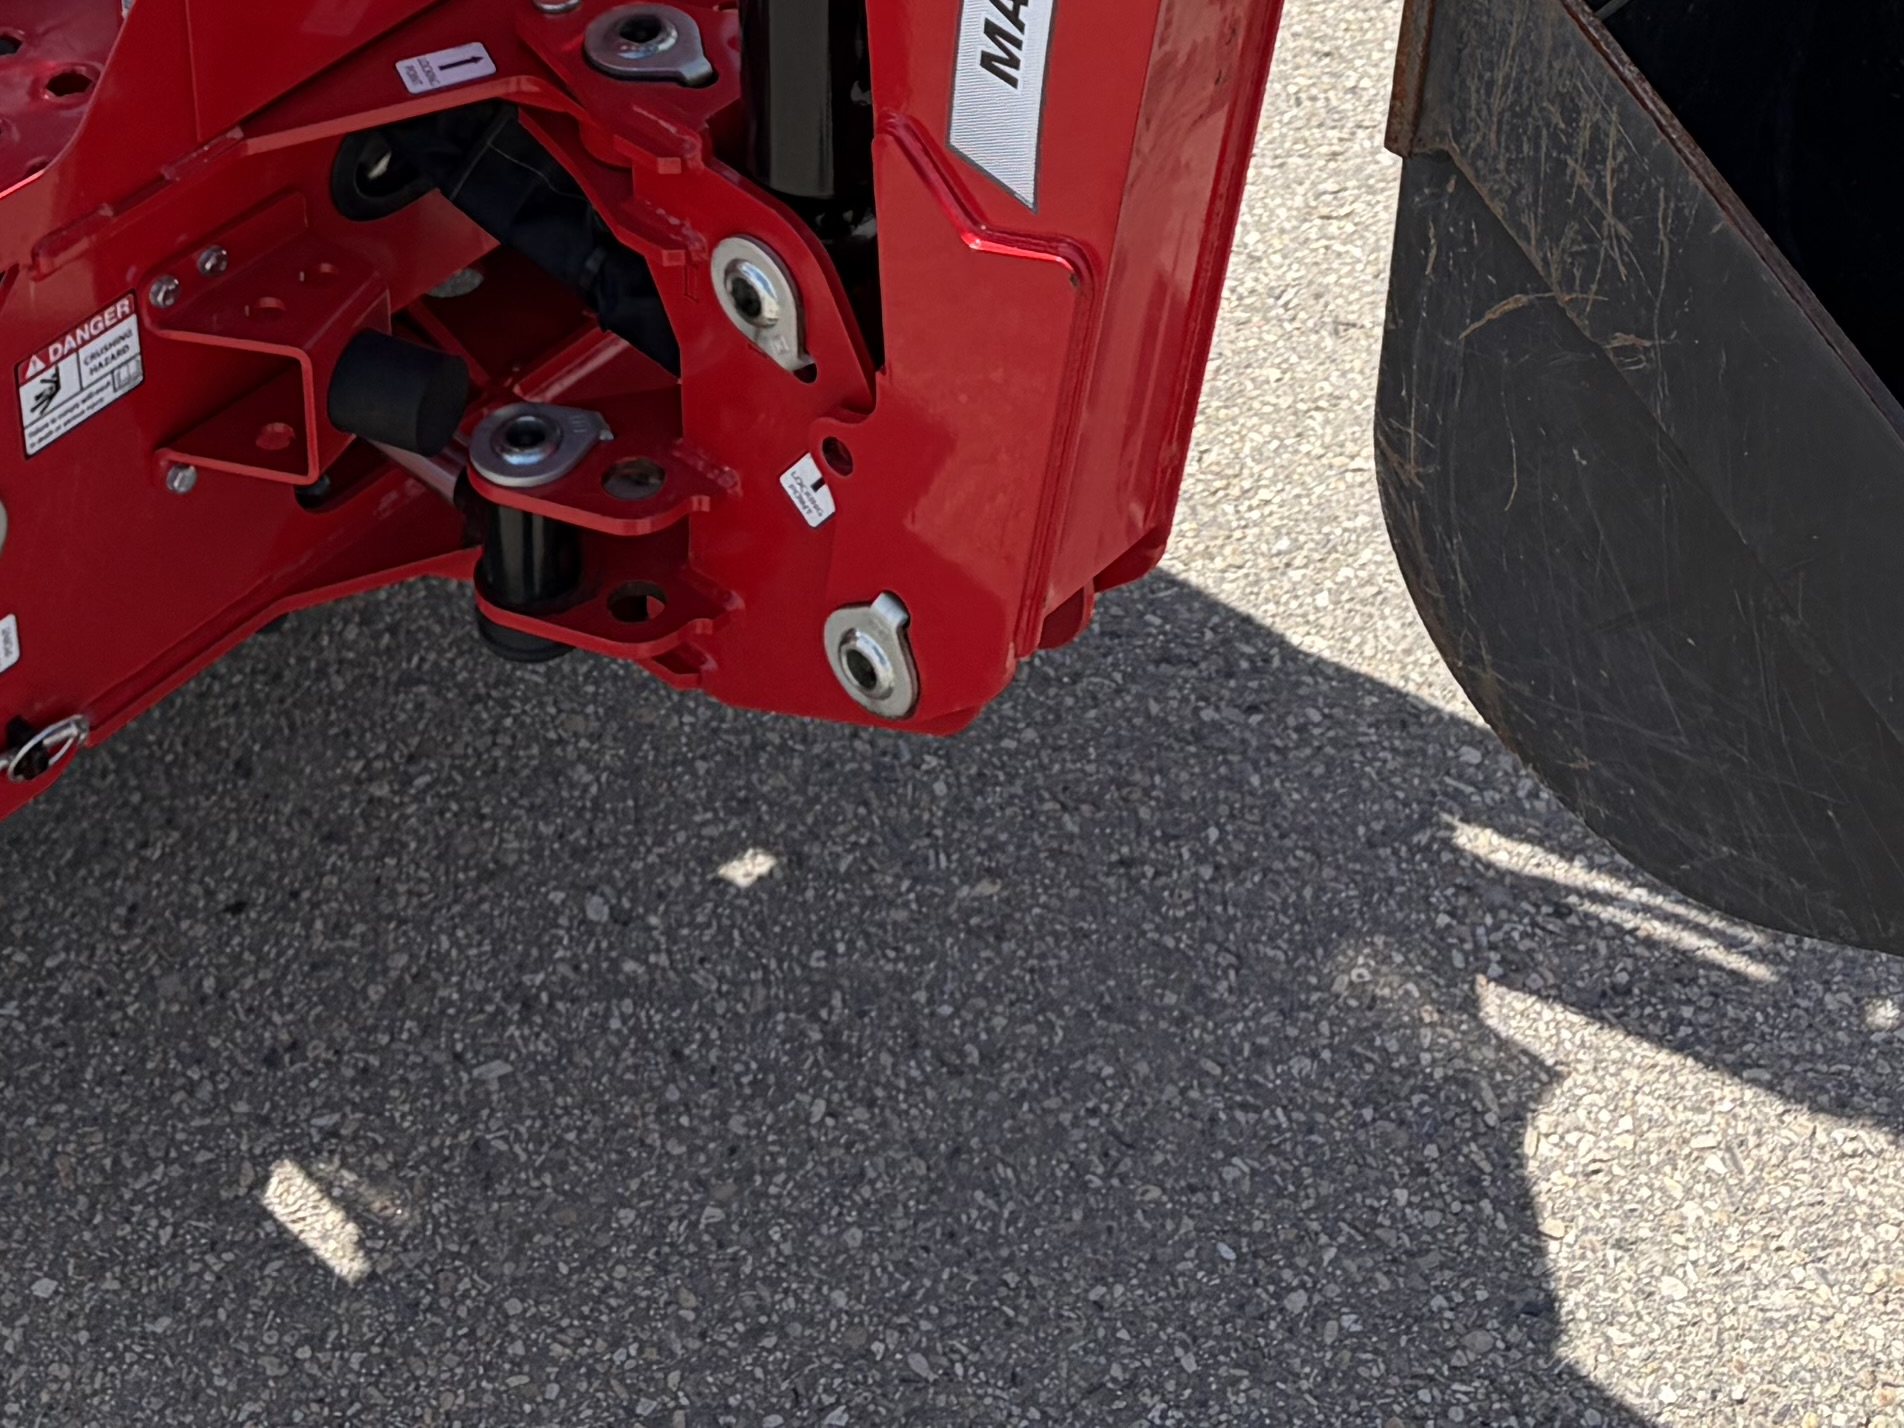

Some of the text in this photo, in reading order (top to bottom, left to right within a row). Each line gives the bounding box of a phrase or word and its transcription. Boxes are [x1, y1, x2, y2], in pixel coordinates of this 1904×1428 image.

[48, 297, 131, 363] DANGER
[83, 328, 133, 367] CRUSHING
[89, 344, 131, 376] HAZARD
[788, 483, 813, 515] POINT
[790, 471, 824, 517] LOCKING
